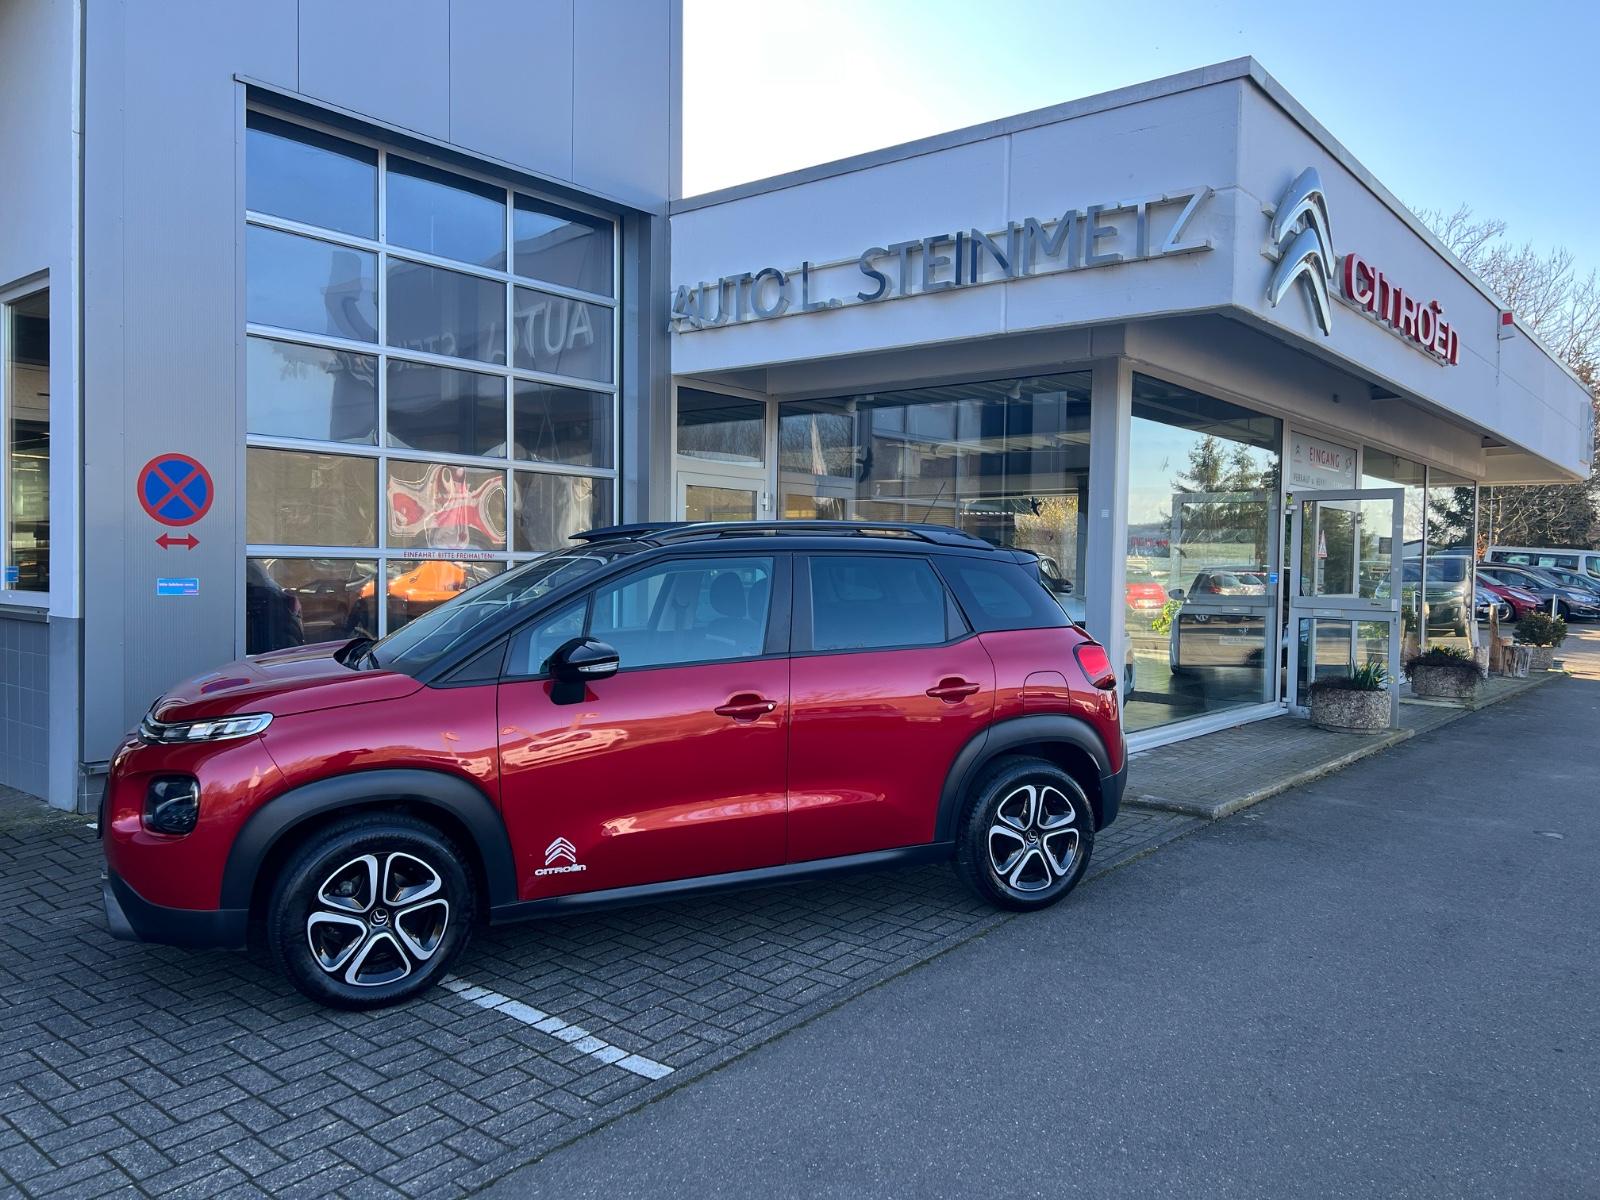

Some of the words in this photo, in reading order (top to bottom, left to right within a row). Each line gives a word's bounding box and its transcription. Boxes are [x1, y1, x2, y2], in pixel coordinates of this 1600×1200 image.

[669, 267, 791, 332] AUTO
[857, 184, 1215, 301] STEINMETZ
[1309, 446, 1340, 470] EINGANG
